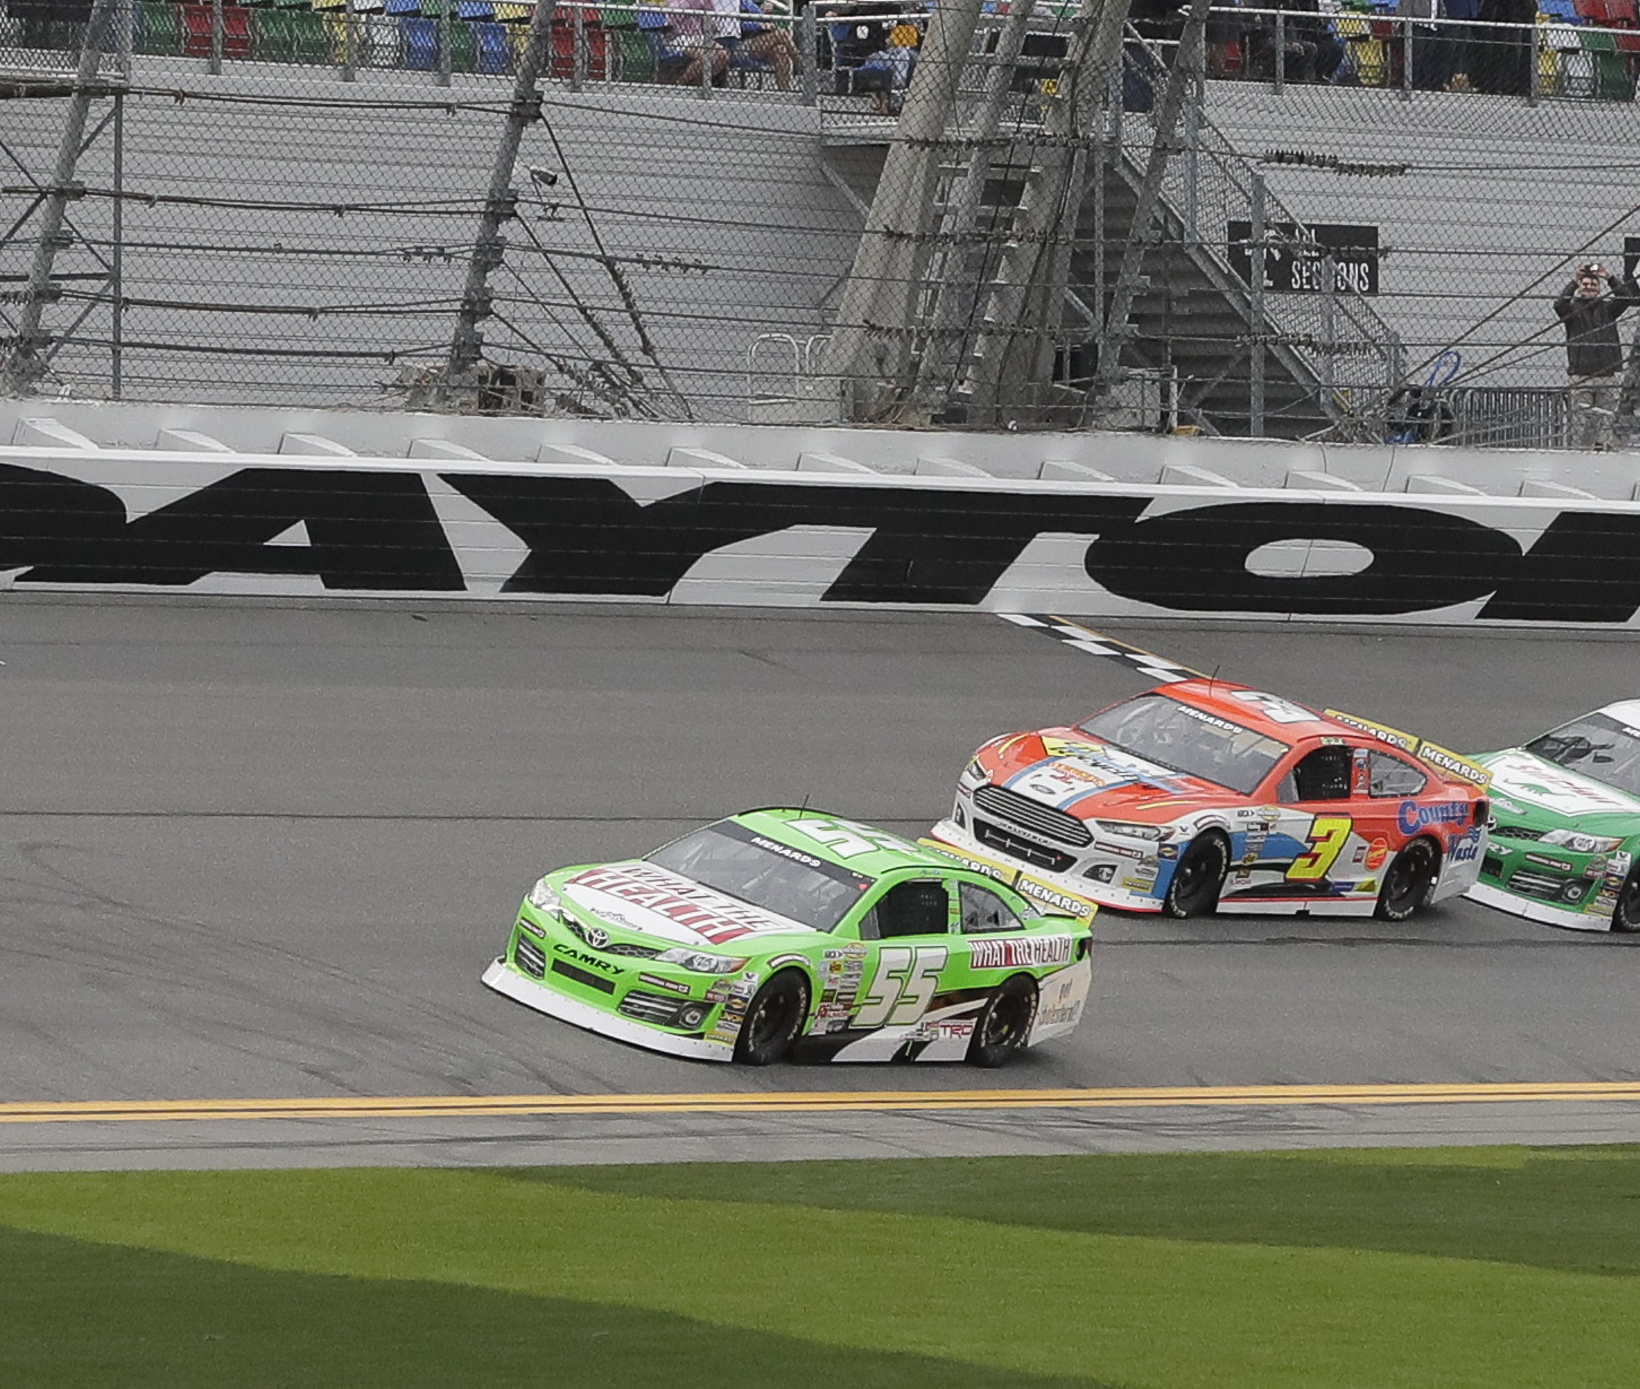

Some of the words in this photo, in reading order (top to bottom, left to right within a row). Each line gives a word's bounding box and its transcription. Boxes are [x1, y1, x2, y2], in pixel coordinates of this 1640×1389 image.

[1291, 260, 1370, 292] SECONS
[1177, 705, 1244, 734] MENARDS
[1422, 746, 1488, 786] MENARDS
[1398, 799, 1469, 836] County
[750, 837, 821, 867] MENARDS
[1284, 812, 1353, 883] 3
[1020, 878, 1090, 917] MENARDS
[553, 944, 625, 975] CAMRY
[968, 940, 1008, 968] WHAT
[850, 946, 947, 1028] 55
